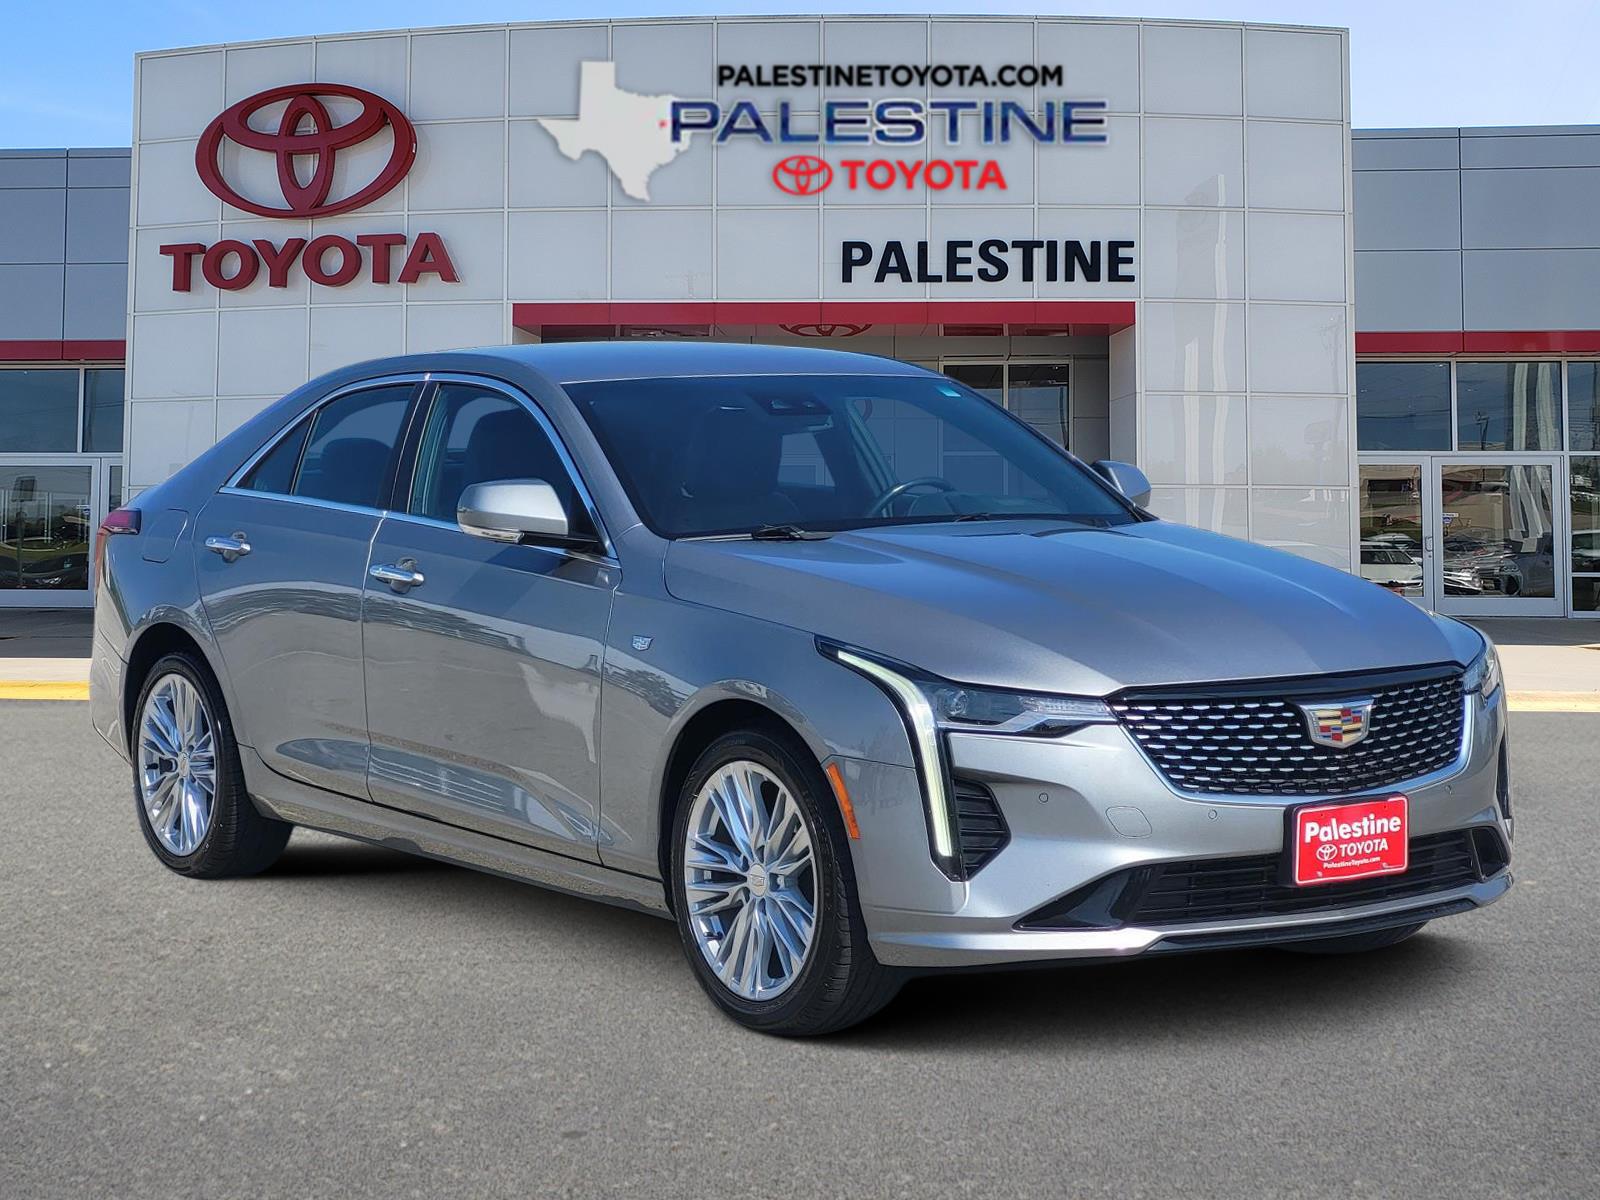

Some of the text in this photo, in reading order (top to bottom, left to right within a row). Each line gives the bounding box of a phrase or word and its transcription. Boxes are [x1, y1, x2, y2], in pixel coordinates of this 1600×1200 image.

[160, 232, 461, 291] TOYOTA
[842, 240, 1135, 283] PALESTINE
[1304, 814, 1402, 843] Palestine
[1340, 838, 1389, 857] TOYOTA
